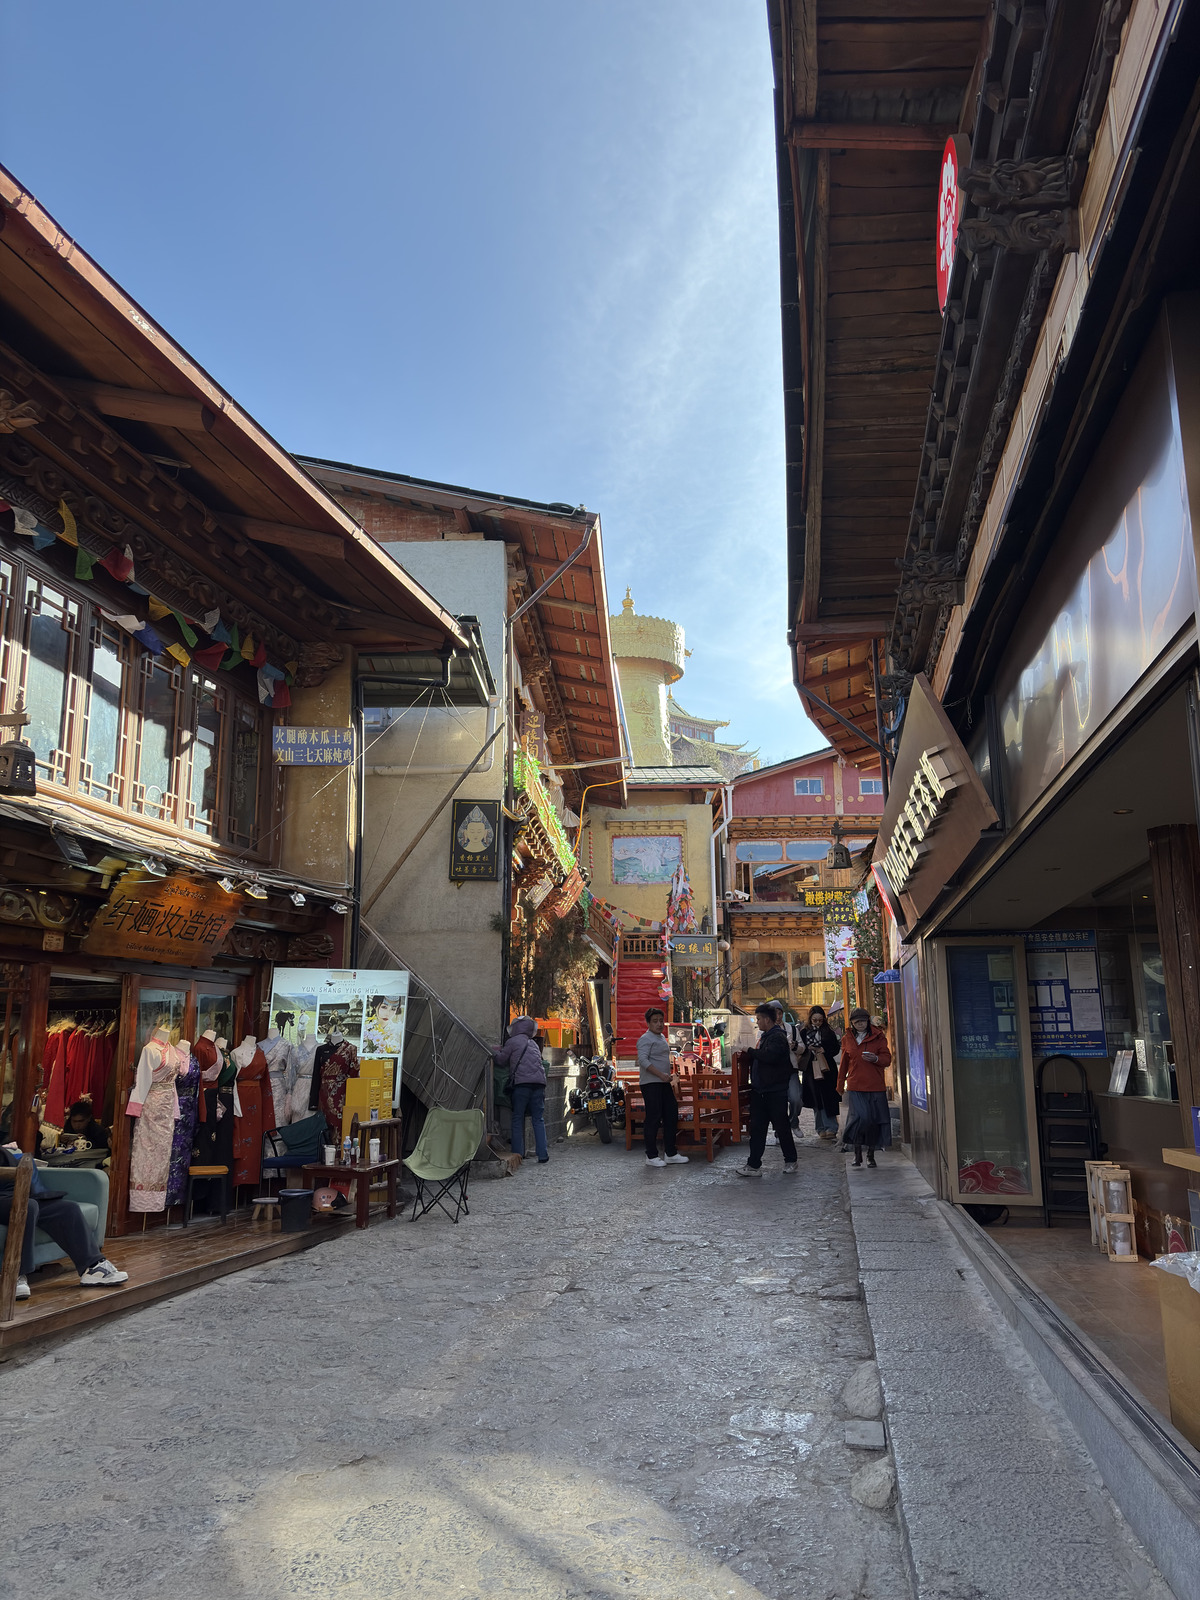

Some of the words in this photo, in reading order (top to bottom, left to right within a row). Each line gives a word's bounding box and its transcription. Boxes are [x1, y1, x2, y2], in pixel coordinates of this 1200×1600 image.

[275, 728, 352, 745] 火腿酸木瓜土鸡
[525, 715, 541, 758] 迎缘阁
[275, 747, 352, 763] 文山三七天麻炖鸡
[883, 812, 919, 898] CHAGEE
[903, 750, 946, 842] 霸王茶姬
[103, 894, 226, 944] 纤婳妆造馆
[675, 942, 712, 955] 迎缘阁
[961, 1034, 989, 1042] 投诉电话
